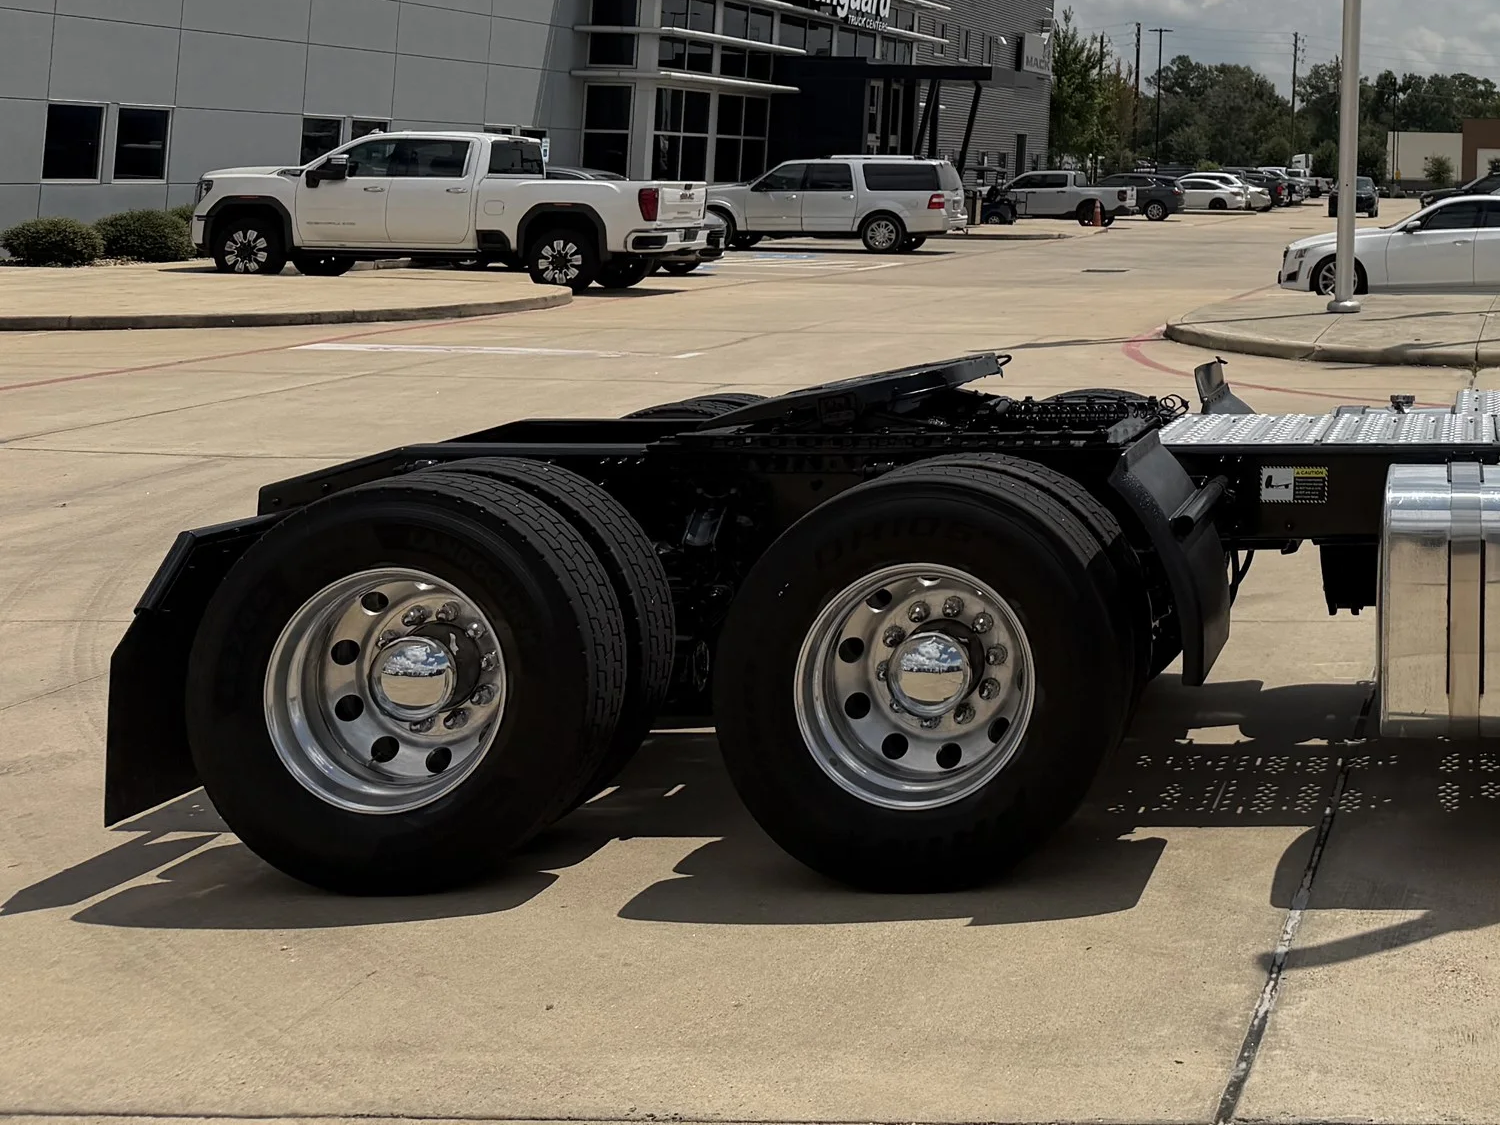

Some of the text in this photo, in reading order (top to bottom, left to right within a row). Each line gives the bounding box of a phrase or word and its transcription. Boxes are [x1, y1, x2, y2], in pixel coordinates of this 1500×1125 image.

[848, 15, 888, 32] TRUCK CENTERS
[1025, 55, 1050, 71] MACK
